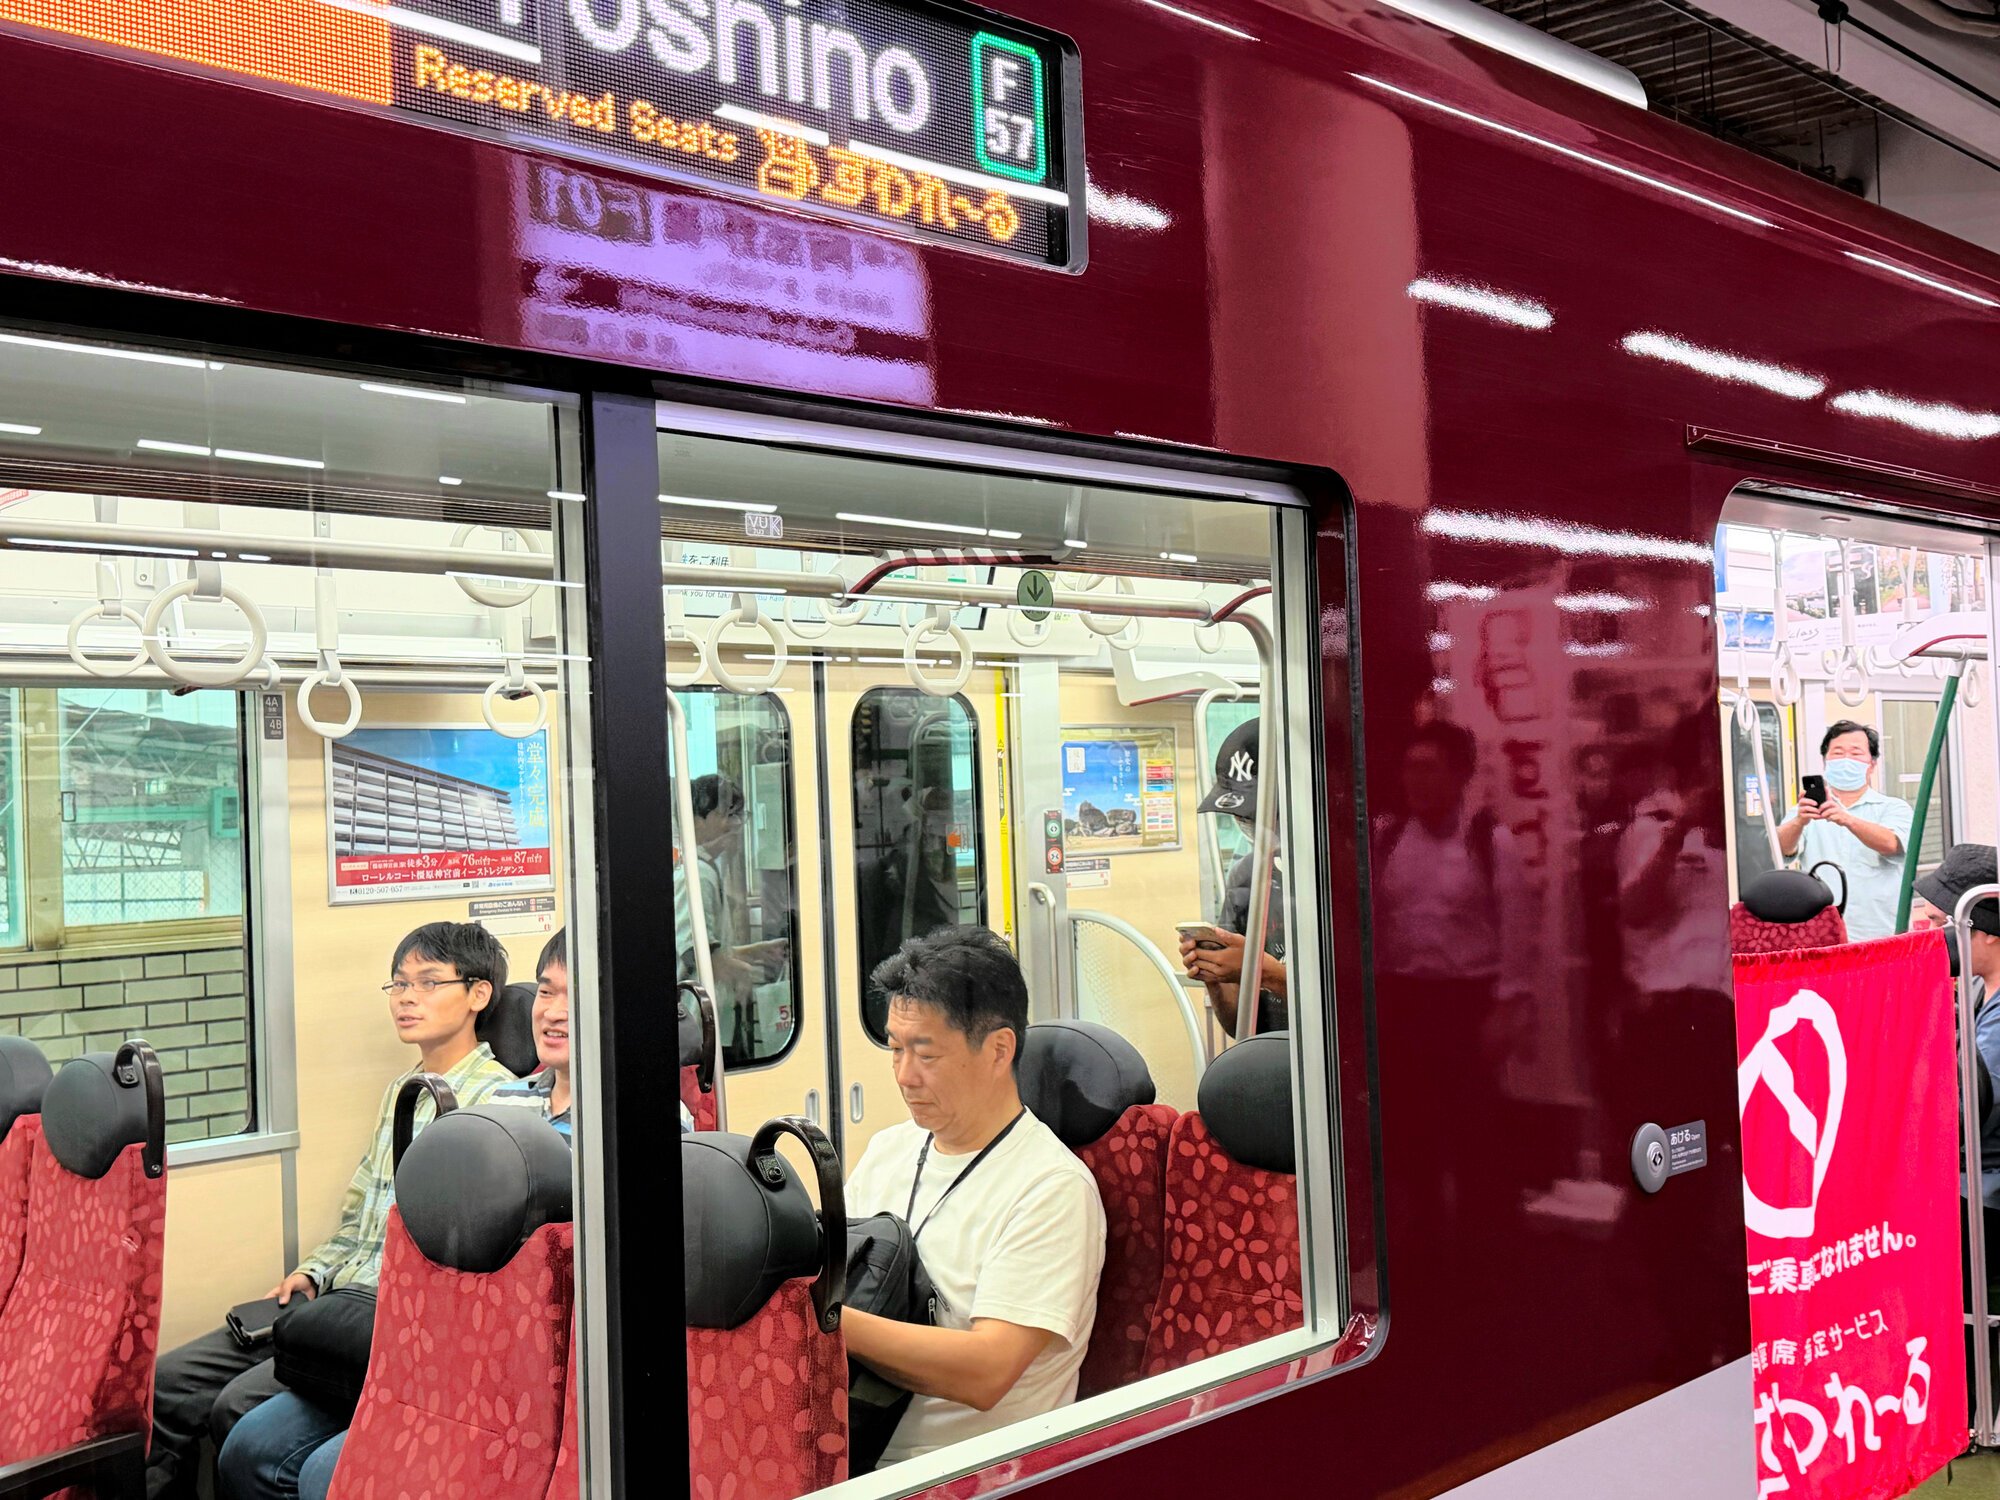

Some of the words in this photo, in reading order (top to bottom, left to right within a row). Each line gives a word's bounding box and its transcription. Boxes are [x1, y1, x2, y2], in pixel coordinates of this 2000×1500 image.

[498, 0, 932, 133] oshino
[990, 57, 1020, 101] F
[413, 43, 617, 133] Reserved
[629, 99, 739, 162] Seats
[984, 107, 1034, 160] 57
[265, 696, 278, 708] 4A
[270, 719, 282, 730] 4B
[1228, 750, 1255, 782] NY
[1670, 1129, 1691, 1146] あける
